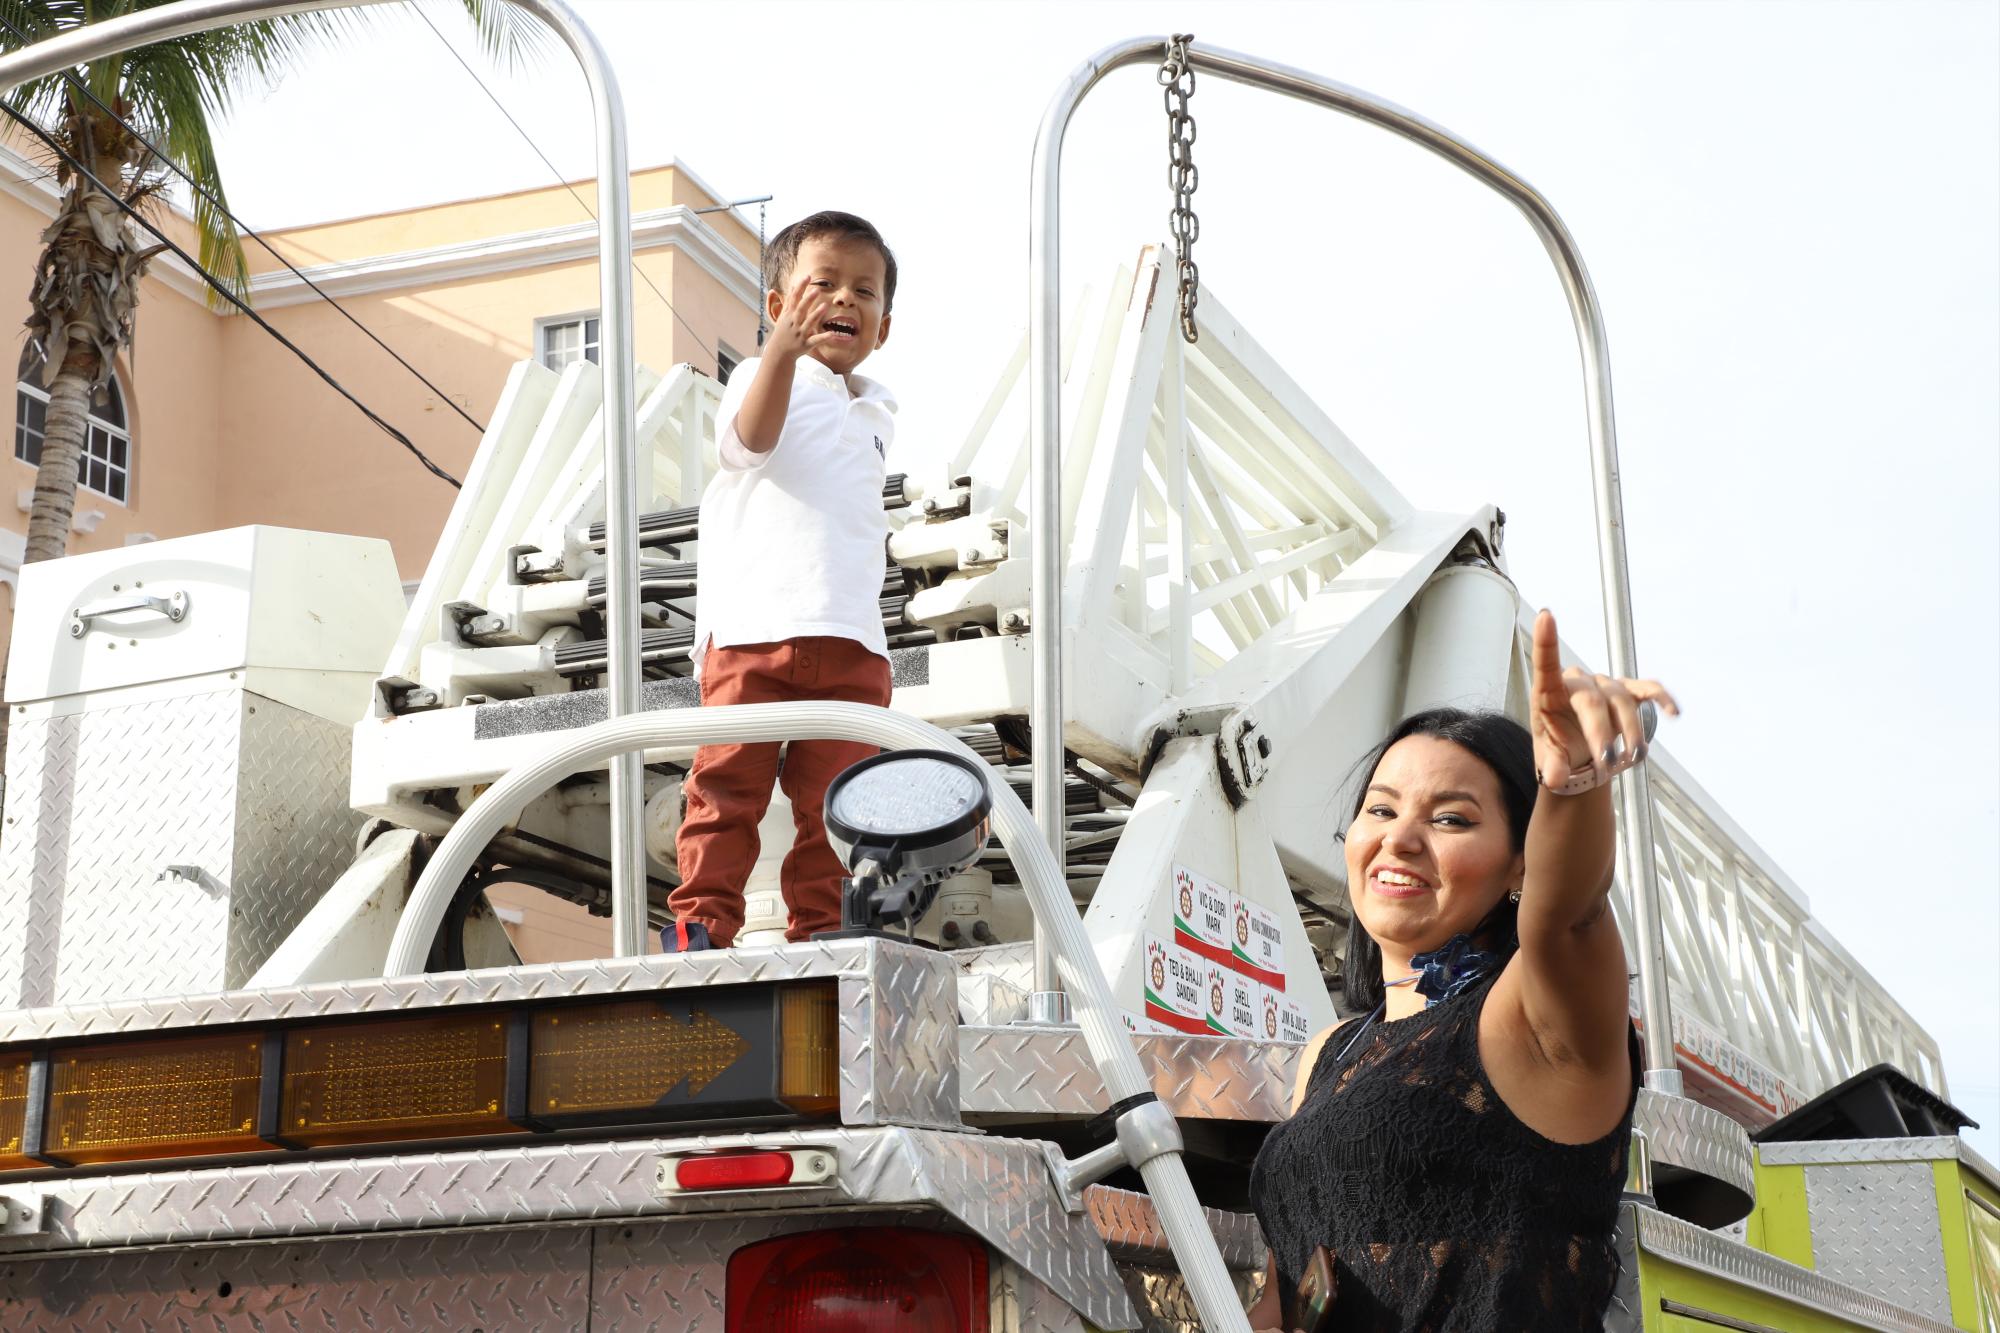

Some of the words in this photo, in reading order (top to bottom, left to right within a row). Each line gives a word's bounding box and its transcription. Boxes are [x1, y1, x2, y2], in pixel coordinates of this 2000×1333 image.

[1209, 896, 1213, 911] &
[1205, 912, 1222, 935] MARK
[1169, 958, 1179, 977] TED
[1180, 963, 1185, 979] &
[1176, 981, 1198, 1005] SANDHU
[1234, 988, 1250, 1008] SHELL
[1233, 1006, 1253, 1028] CANADA
[1290, 1013, 1295, 1028] &
